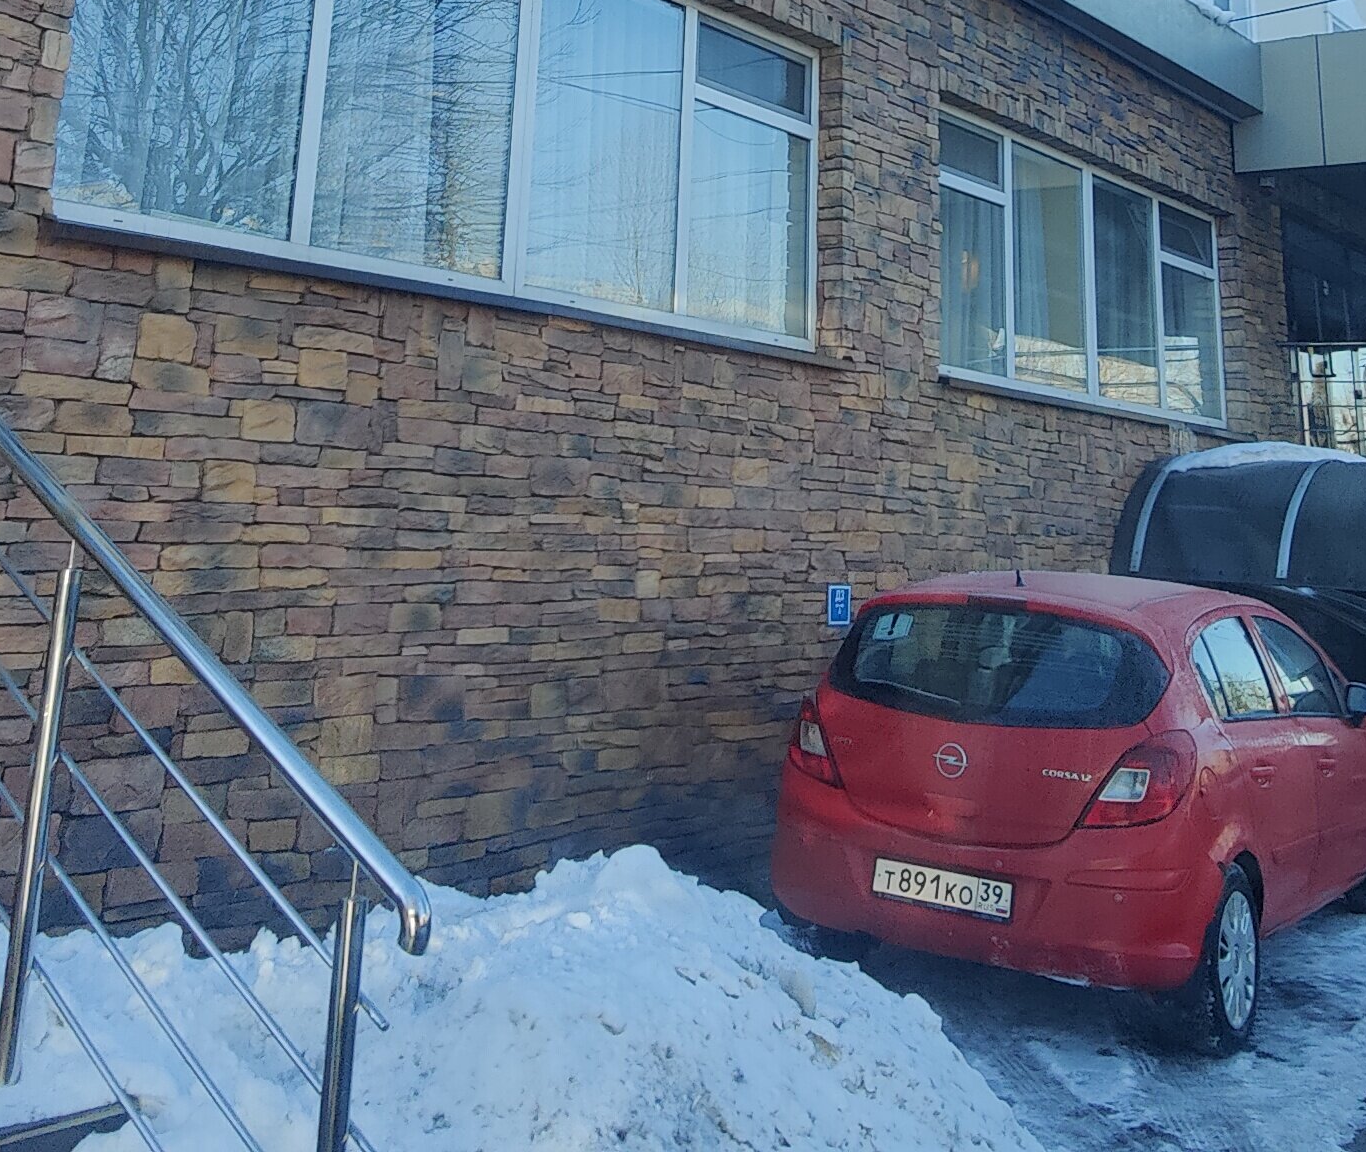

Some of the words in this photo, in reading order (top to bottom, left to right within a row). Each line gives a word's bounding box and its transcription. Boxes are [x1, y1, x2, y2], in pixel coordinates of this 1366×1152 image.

[1042, 768, 1080, 781] CORSA
[885, 868, 973, 905] Т891КО
[979, 881, 1004, 904] 39
